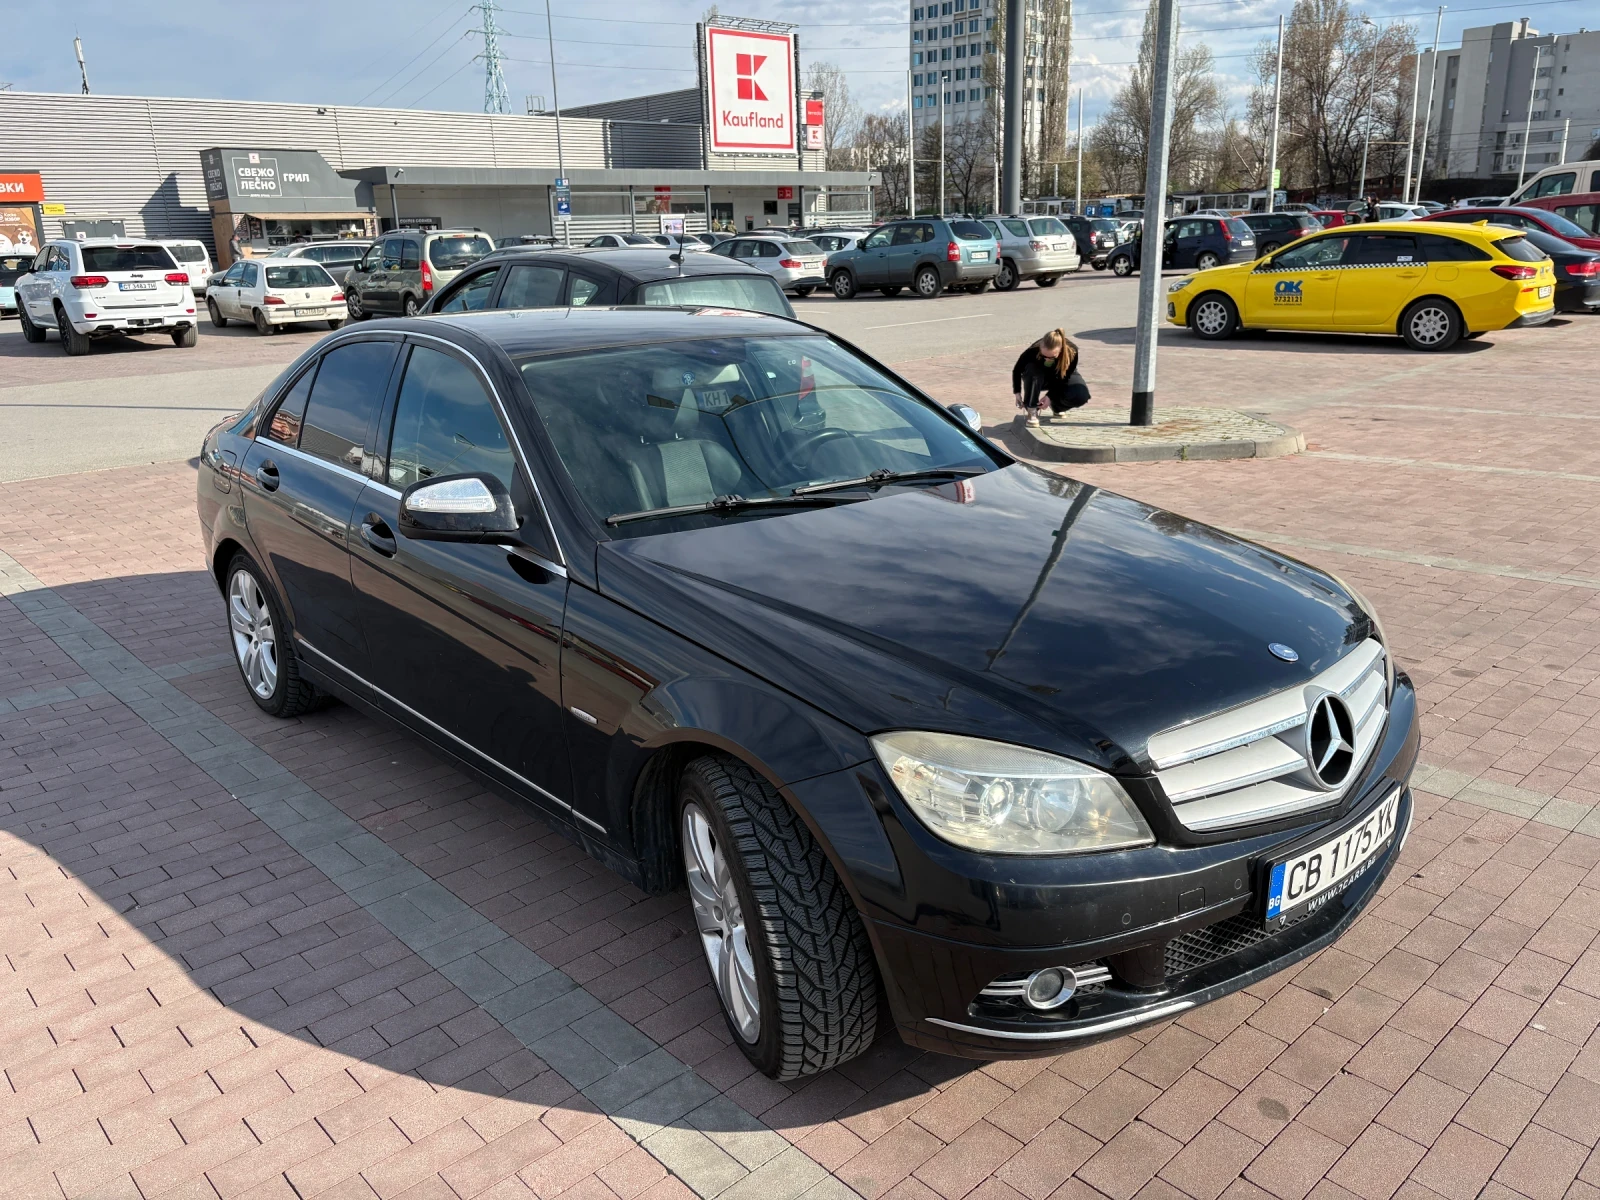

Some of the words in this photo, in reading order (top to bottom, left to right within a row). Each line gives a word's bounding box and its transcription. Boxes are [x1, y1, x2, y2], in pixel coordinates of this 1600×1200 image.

[722, 110, 784, 128] Kaufland
[238, 168, 275, 177] СВЕЖО
[283, 173, 310, 182] ГРИЛ
[241, 181, 276, 190] ЛЕСНО
[1275, 280, 1304, 292] OK
[704, 391, 721, 407] KH
[1287, 853, 1323, 901] CB
[1331, 815, 1375, 878] 1175
[1374, 793, 1398, 844] XK
[1307, 855, 1377, 911] WWW.7CARS.BG
[1269, 895, 1281, 910] BG
